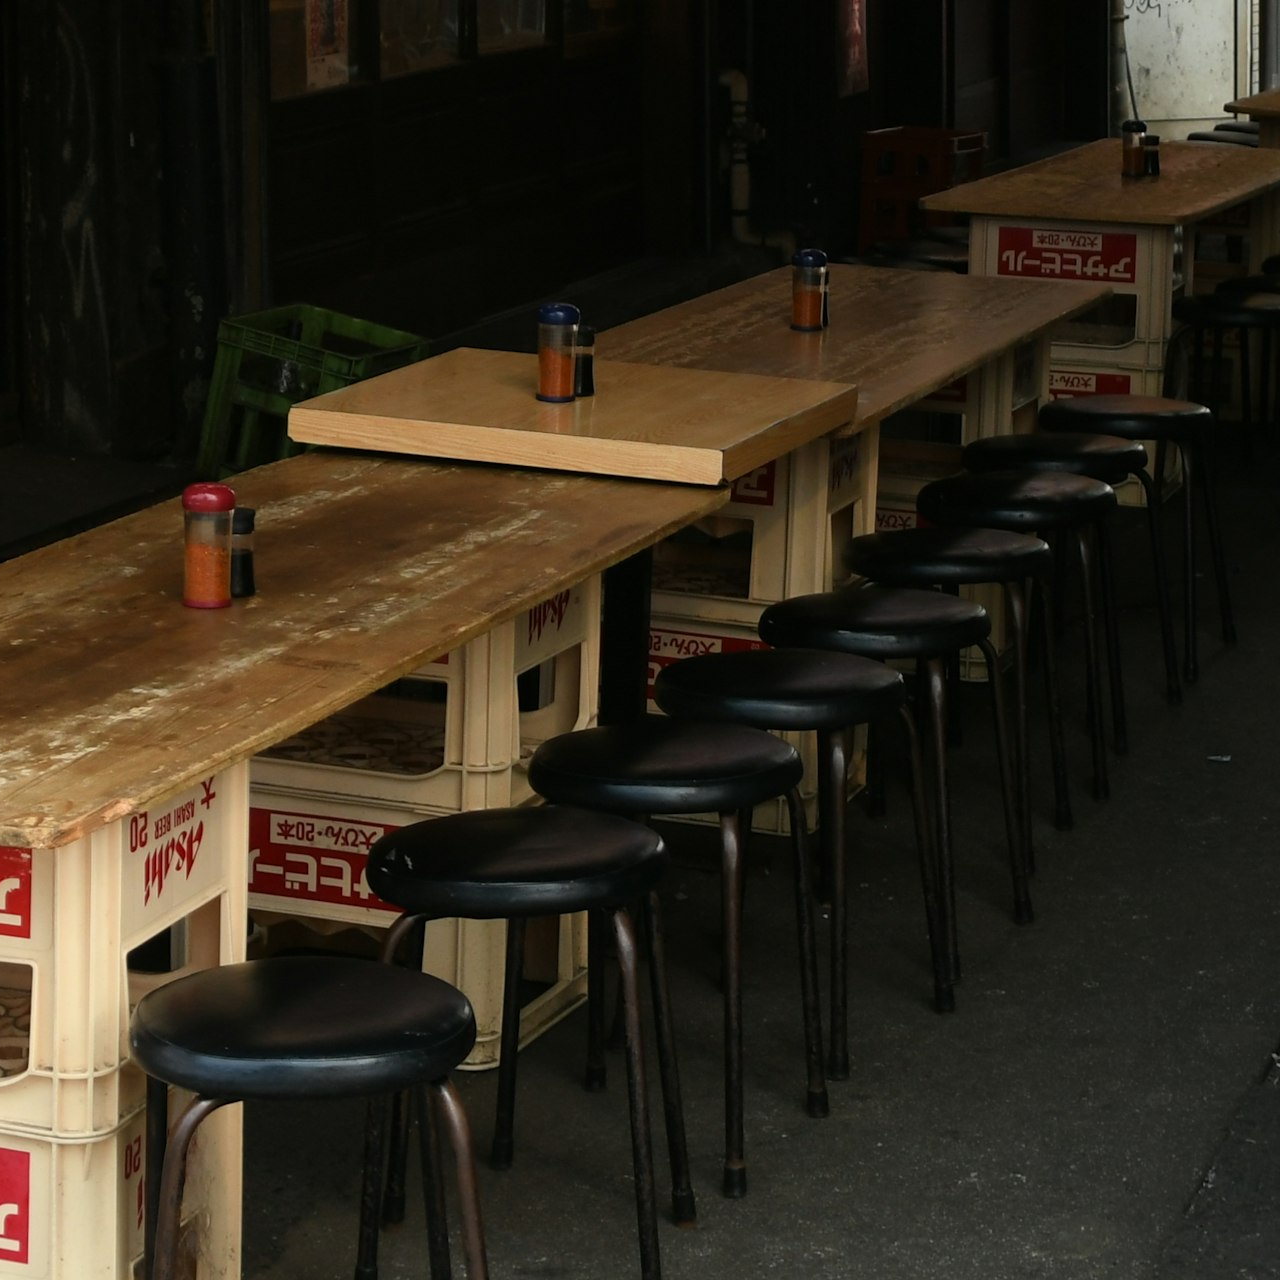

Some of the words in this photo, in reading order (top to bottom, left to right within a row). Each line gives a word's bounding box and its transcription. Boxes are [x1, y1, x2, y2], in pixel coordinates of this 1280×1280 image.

[1001, 249, 1132, 279] アサヒビール
[154, 811, 171, 840] BEER
[173, 797, 195, 828] ASAHI
[130, 812, 148, 854] 20
[143, 819, 204, 908] Asahi
[124, 1135, 142, 1181] 20
